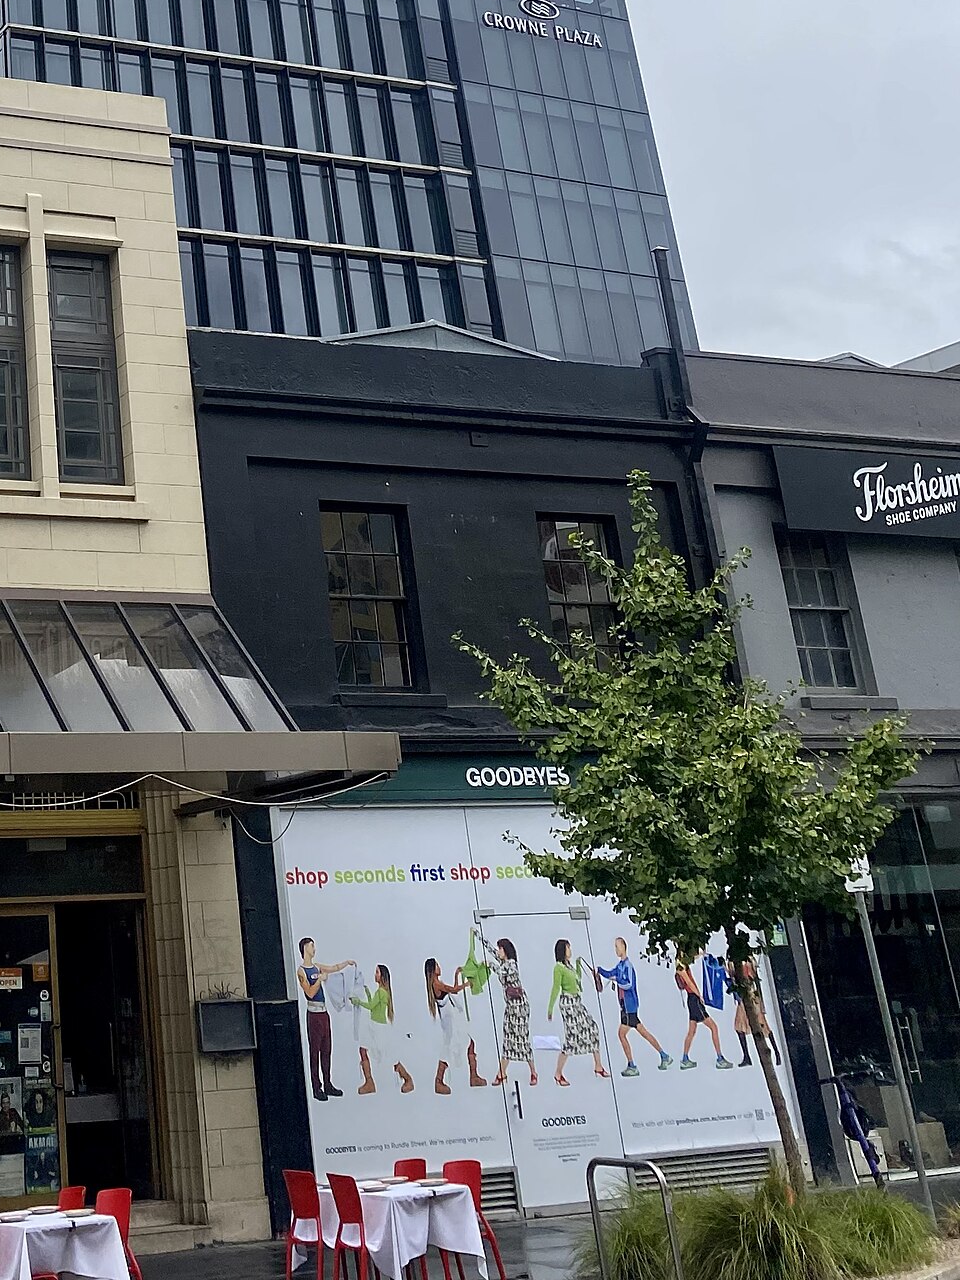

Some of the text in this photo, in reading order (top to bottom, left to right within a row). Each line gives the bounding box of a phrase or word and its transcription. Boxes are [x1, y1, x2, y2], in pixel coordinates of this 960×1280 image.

[483, 11, 603, 48] CROWNE PLAZA
[853, 461, 960, 522] Florsheim
[885, 500, 957, 526] SHOE COMPANY
[466, 766, 570, 787] GOODBYES
[285, 862, 534, 889] shop seconds first shop seco
[541, 1115, 587, 1127] GOODBYES
[325, 1145, 357, 1154] GOODBYES
